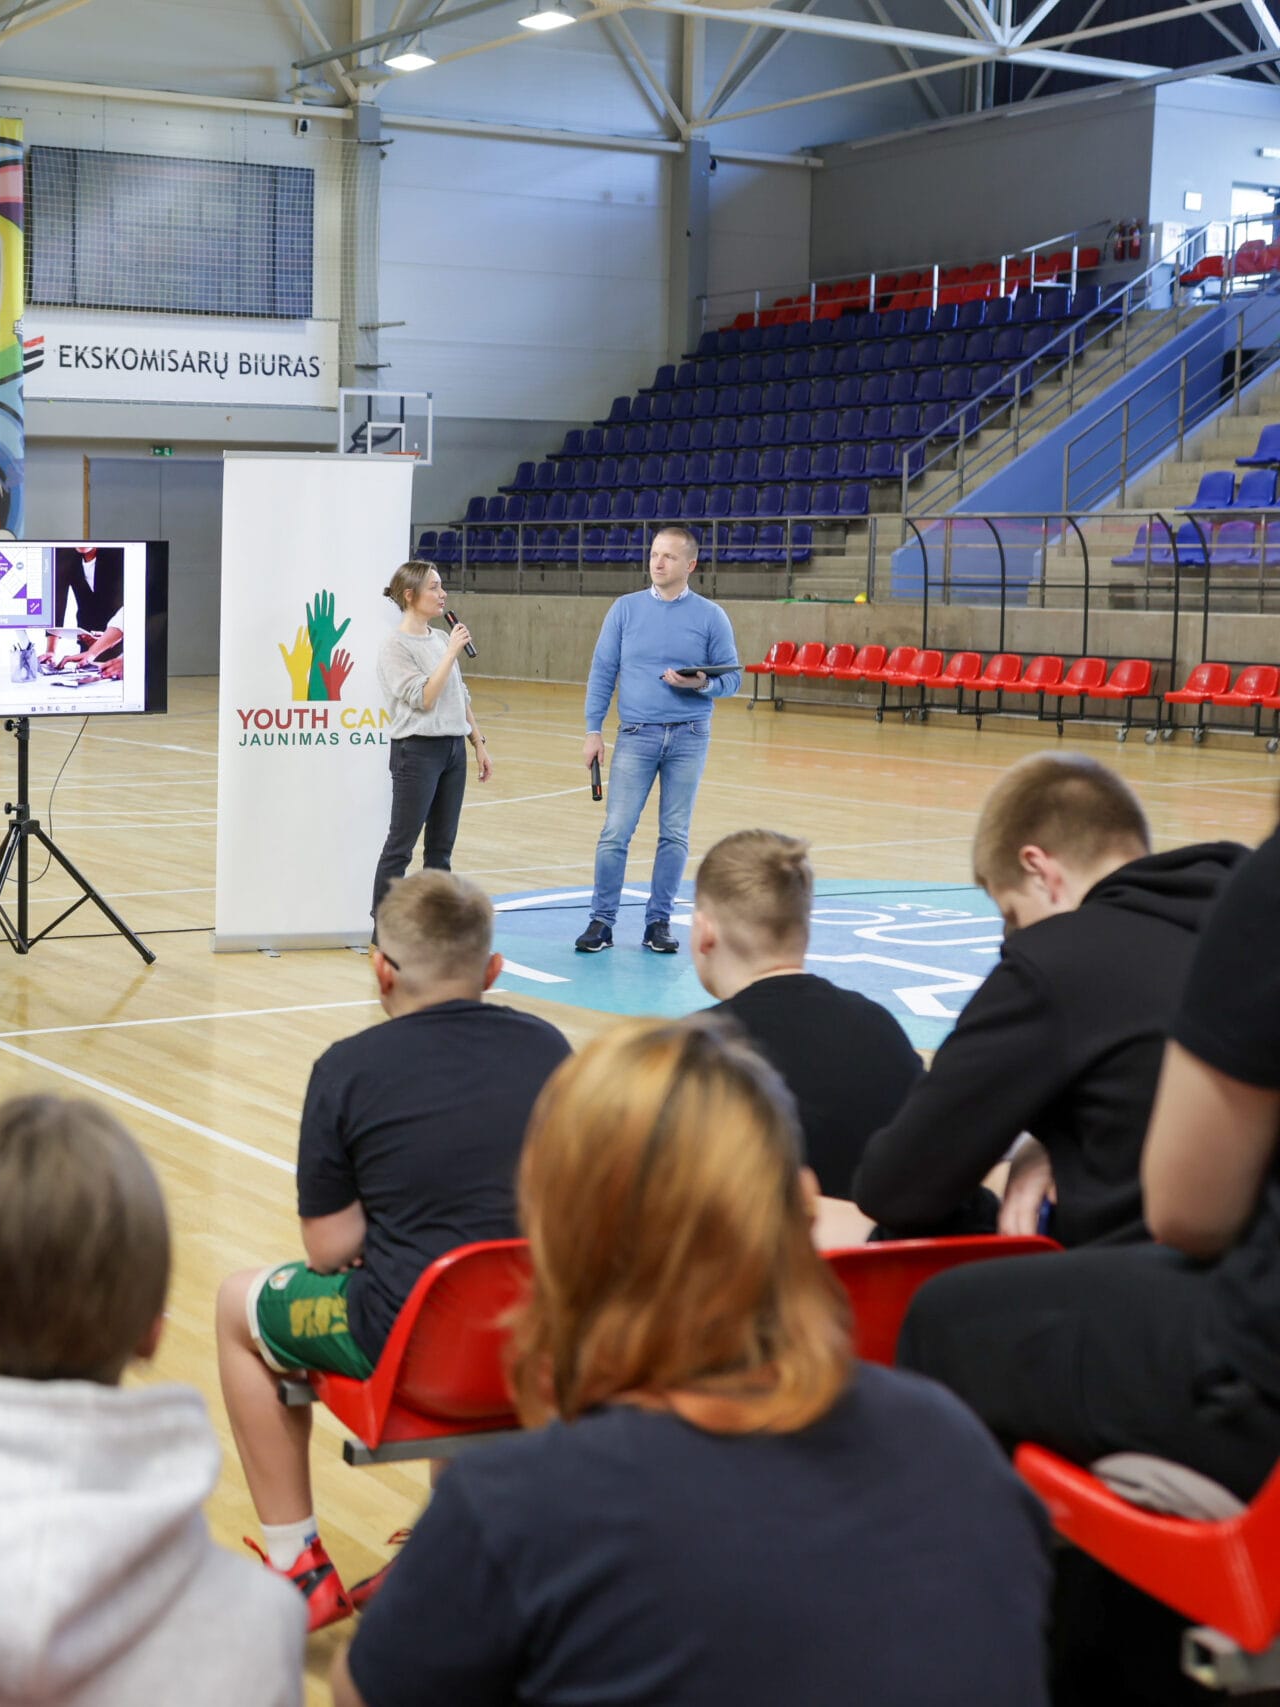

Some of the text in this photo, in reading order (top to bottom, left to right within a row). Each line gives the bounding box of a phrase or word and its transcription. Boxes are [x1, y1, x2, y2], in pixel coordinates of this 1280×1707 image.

[58, 344, 321, 379] EKSKOMISARŲ BIURAS
[236, 708, 393, 730] YOUTH CAN
[239, 732, 389, 746] JAUNIMAS GAL
